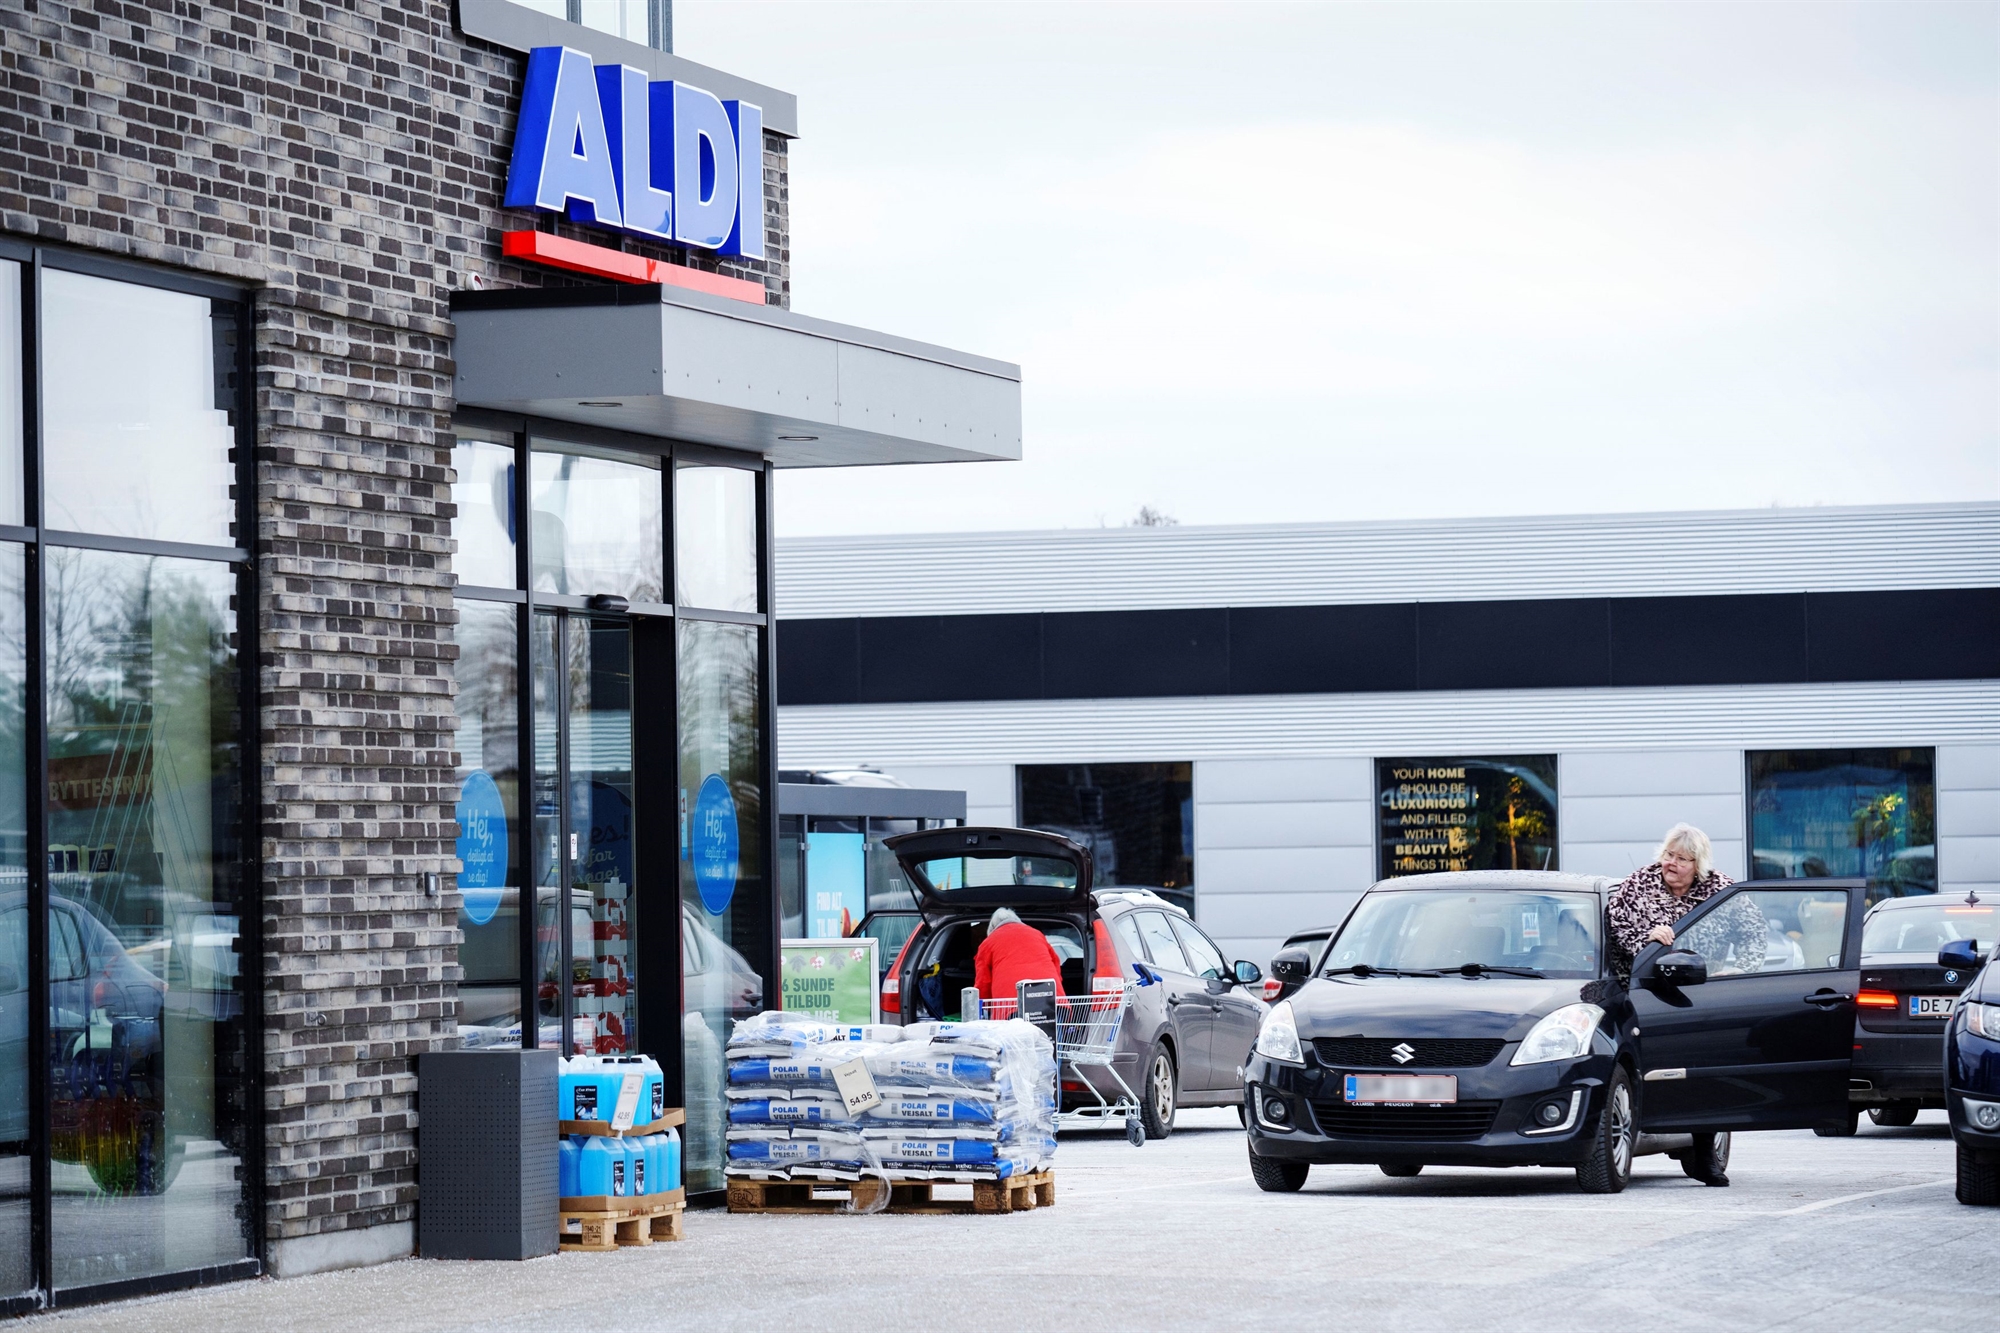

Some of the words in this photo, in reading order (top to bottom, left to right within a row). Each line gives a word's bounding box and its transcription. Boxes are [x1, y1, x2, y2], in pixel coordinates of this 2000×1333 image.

[505, 46, 765, 261] ALDI
[1392, 768, 1425, 779] YOUR
[1427, 767, 1466, 779] HOME
[1400, 783, 1448, 794] SHOULD
[1450, 782, 1466, 794] BE
[1390, 798, 1467, 810] LUXURIOUS
[1400, 814, 1425, 825] AND
[1427, 813, 1467, 825] FILLED
[467, 808, 494, 848] Hej,
[705, 809, 727, 845] Hej,
[1404, 829, 1434, 840] WITH
[1395, 844, 1448, 855] BEAUTY
[1451, 844, 1467, 855] OF
[1393, 859, 1437, 870] THINGS
[831, 891, 843, 911] ALT
[793, 978, 835, 992] SUNDE
[785, 994, 831, 1009] TILBUD
[1921, 999, 1940, 1012] DE
[850, 1091, 873, 1106] 54.95
